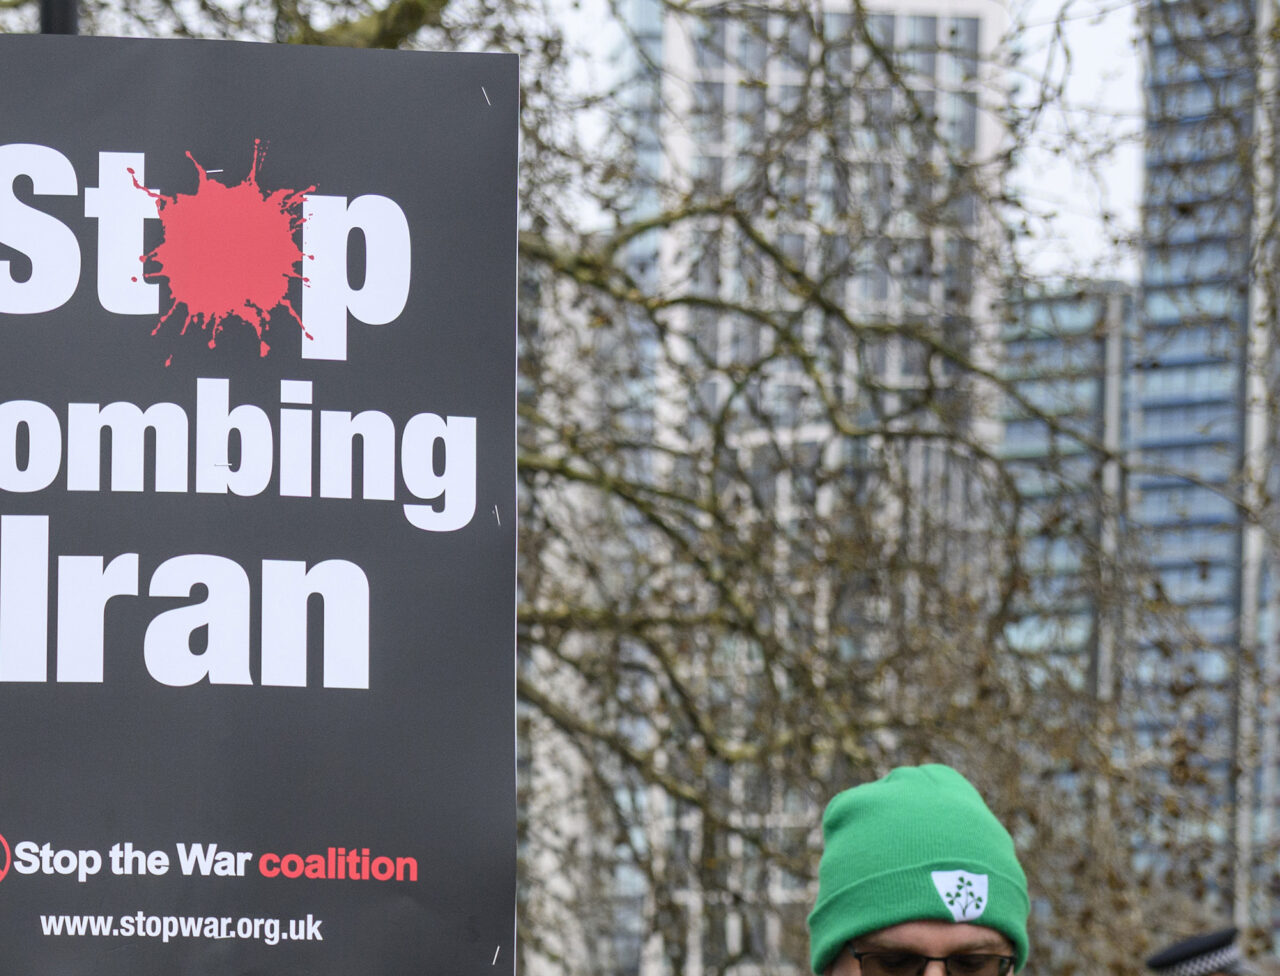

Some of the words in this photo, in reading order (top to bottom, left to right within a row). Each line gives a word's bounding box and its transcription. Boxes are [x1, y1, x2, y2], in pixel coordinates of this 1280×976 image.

[0, 515, 370, 690] Iran
[13, 841, 101, 882] Stop
[109, 842, 170, 876] the
[176, 843, 254, 877] War
[258, 847, 418, 882] coalition
[40, 911, 324, 945] www.stopwar.org.uk
